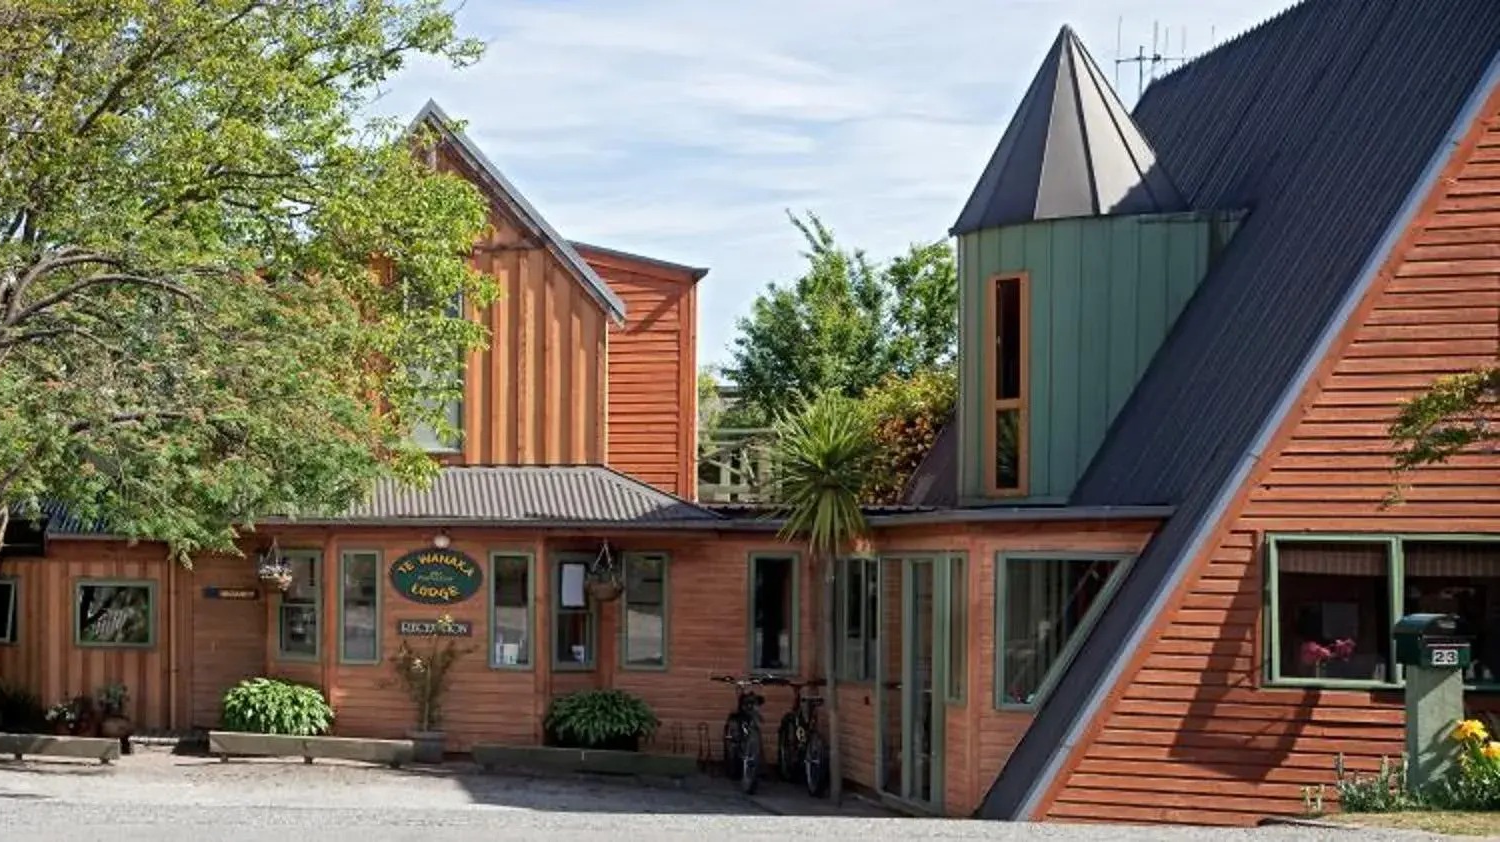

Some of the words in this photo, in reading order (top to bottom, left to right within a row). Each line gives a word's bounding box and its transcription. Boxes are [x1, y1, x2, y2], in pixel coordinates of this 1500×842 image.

[397, 560, 416, 573] TE
[419, 553, 475, 577] WANAKA
[411, 582, 460, 600] LODGE
[1434, 651, 1456, 663] 23
